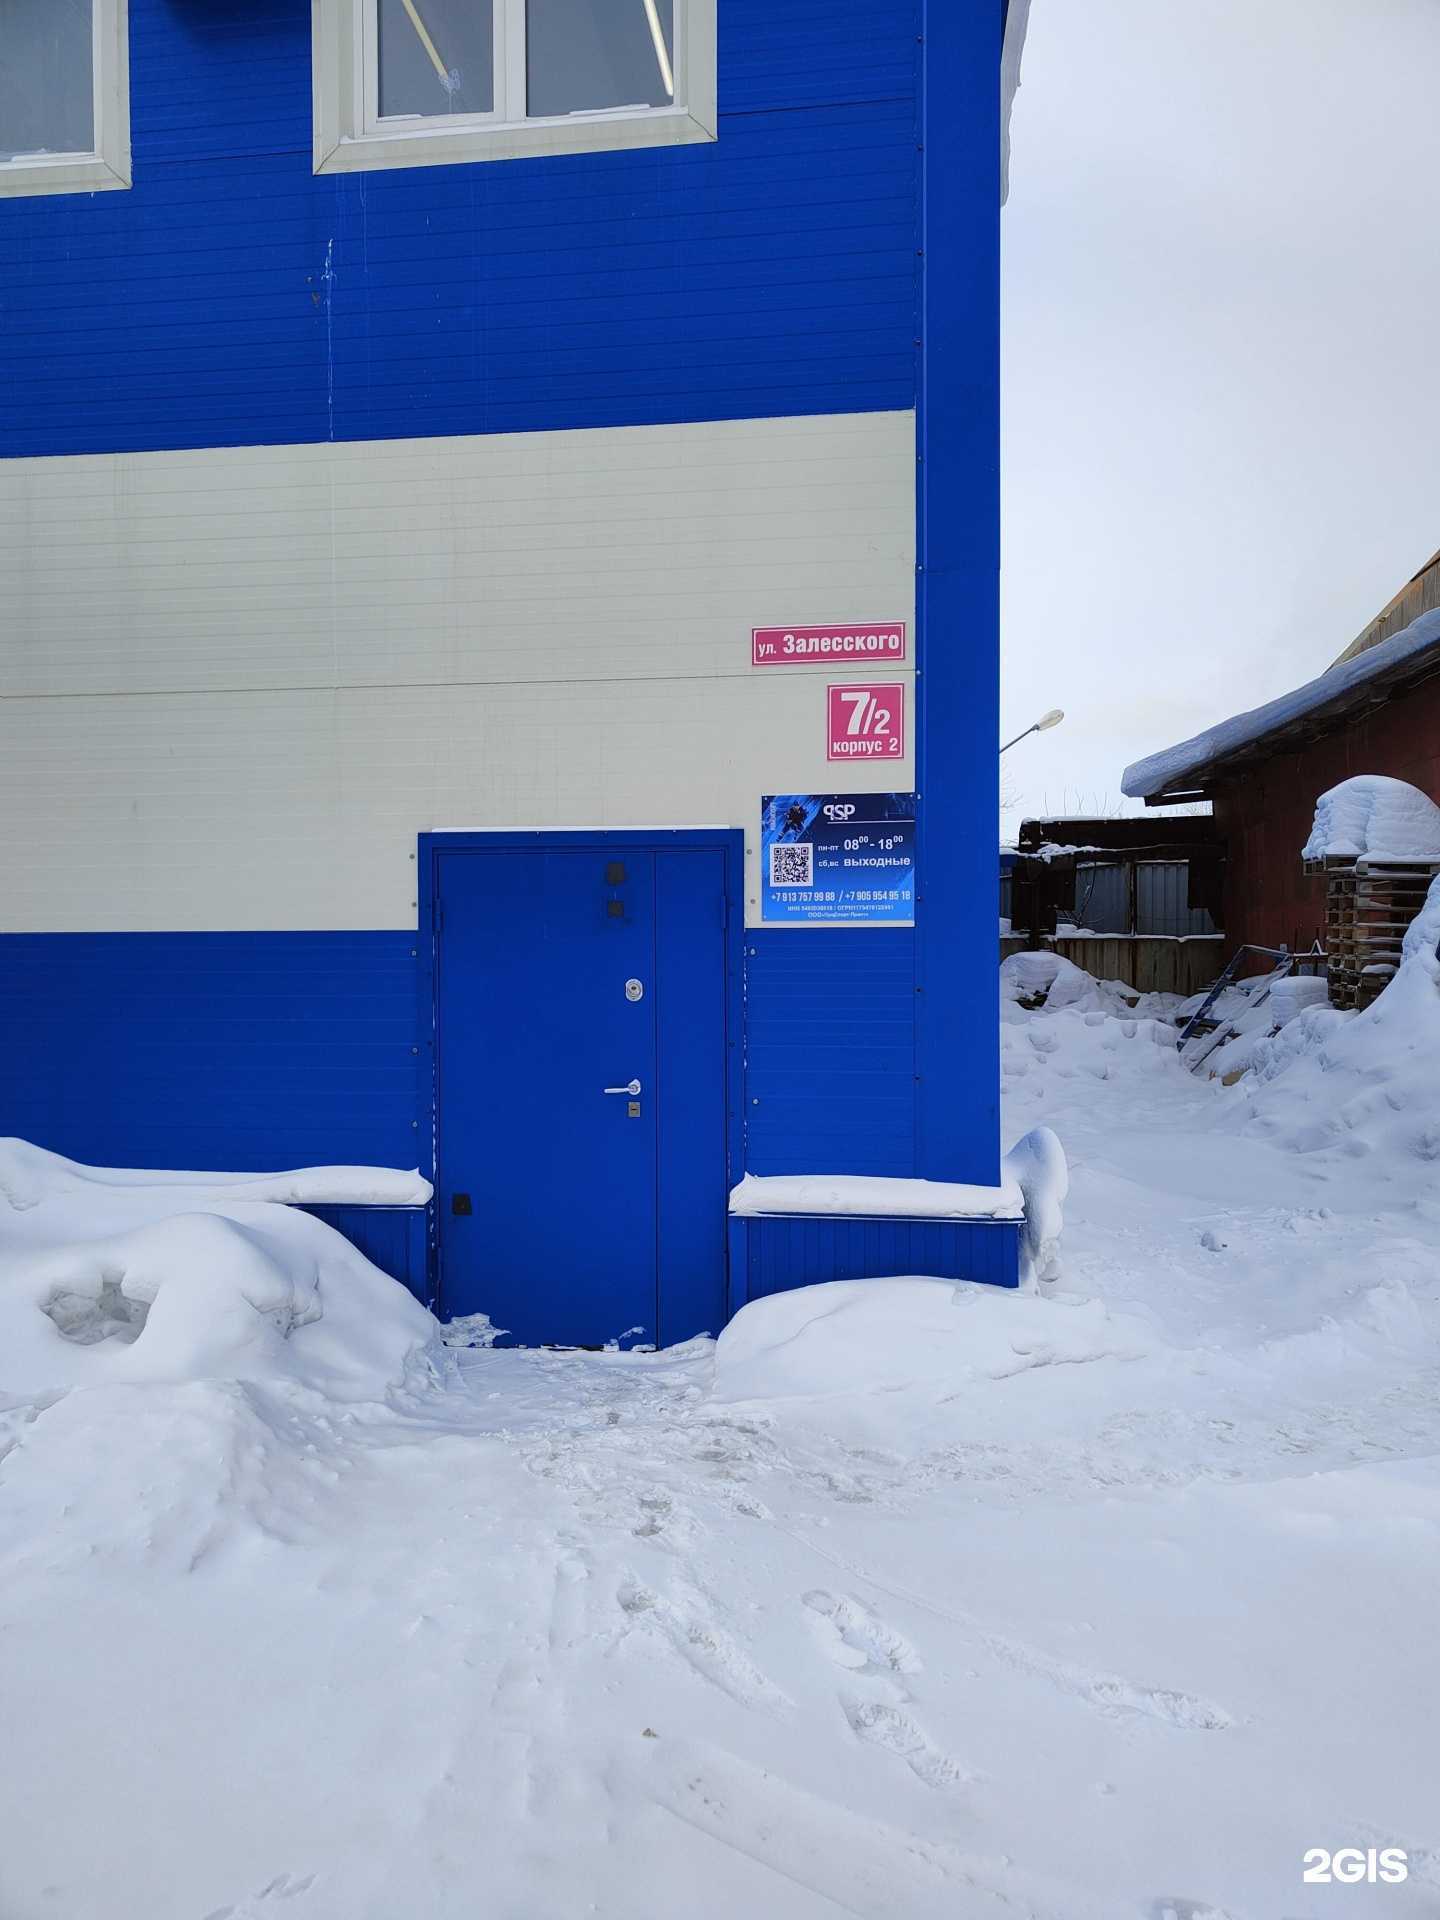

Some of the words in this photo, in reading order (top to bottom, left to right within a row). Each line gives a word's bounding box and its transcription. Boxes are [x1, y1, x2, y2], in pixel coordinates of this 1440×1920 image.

[758, 643, 777, 657] ул.
[783, 634, 899, 654] Залесского
[841, 691, 891, 735] 7/2
[833, 740, 883, 755] корпус
[889, 737, 898, 751] 2
[843, 857, 911, 867] выходные
[856, 891, 871, 901] 905
[872, 891, 887, 901] 954
